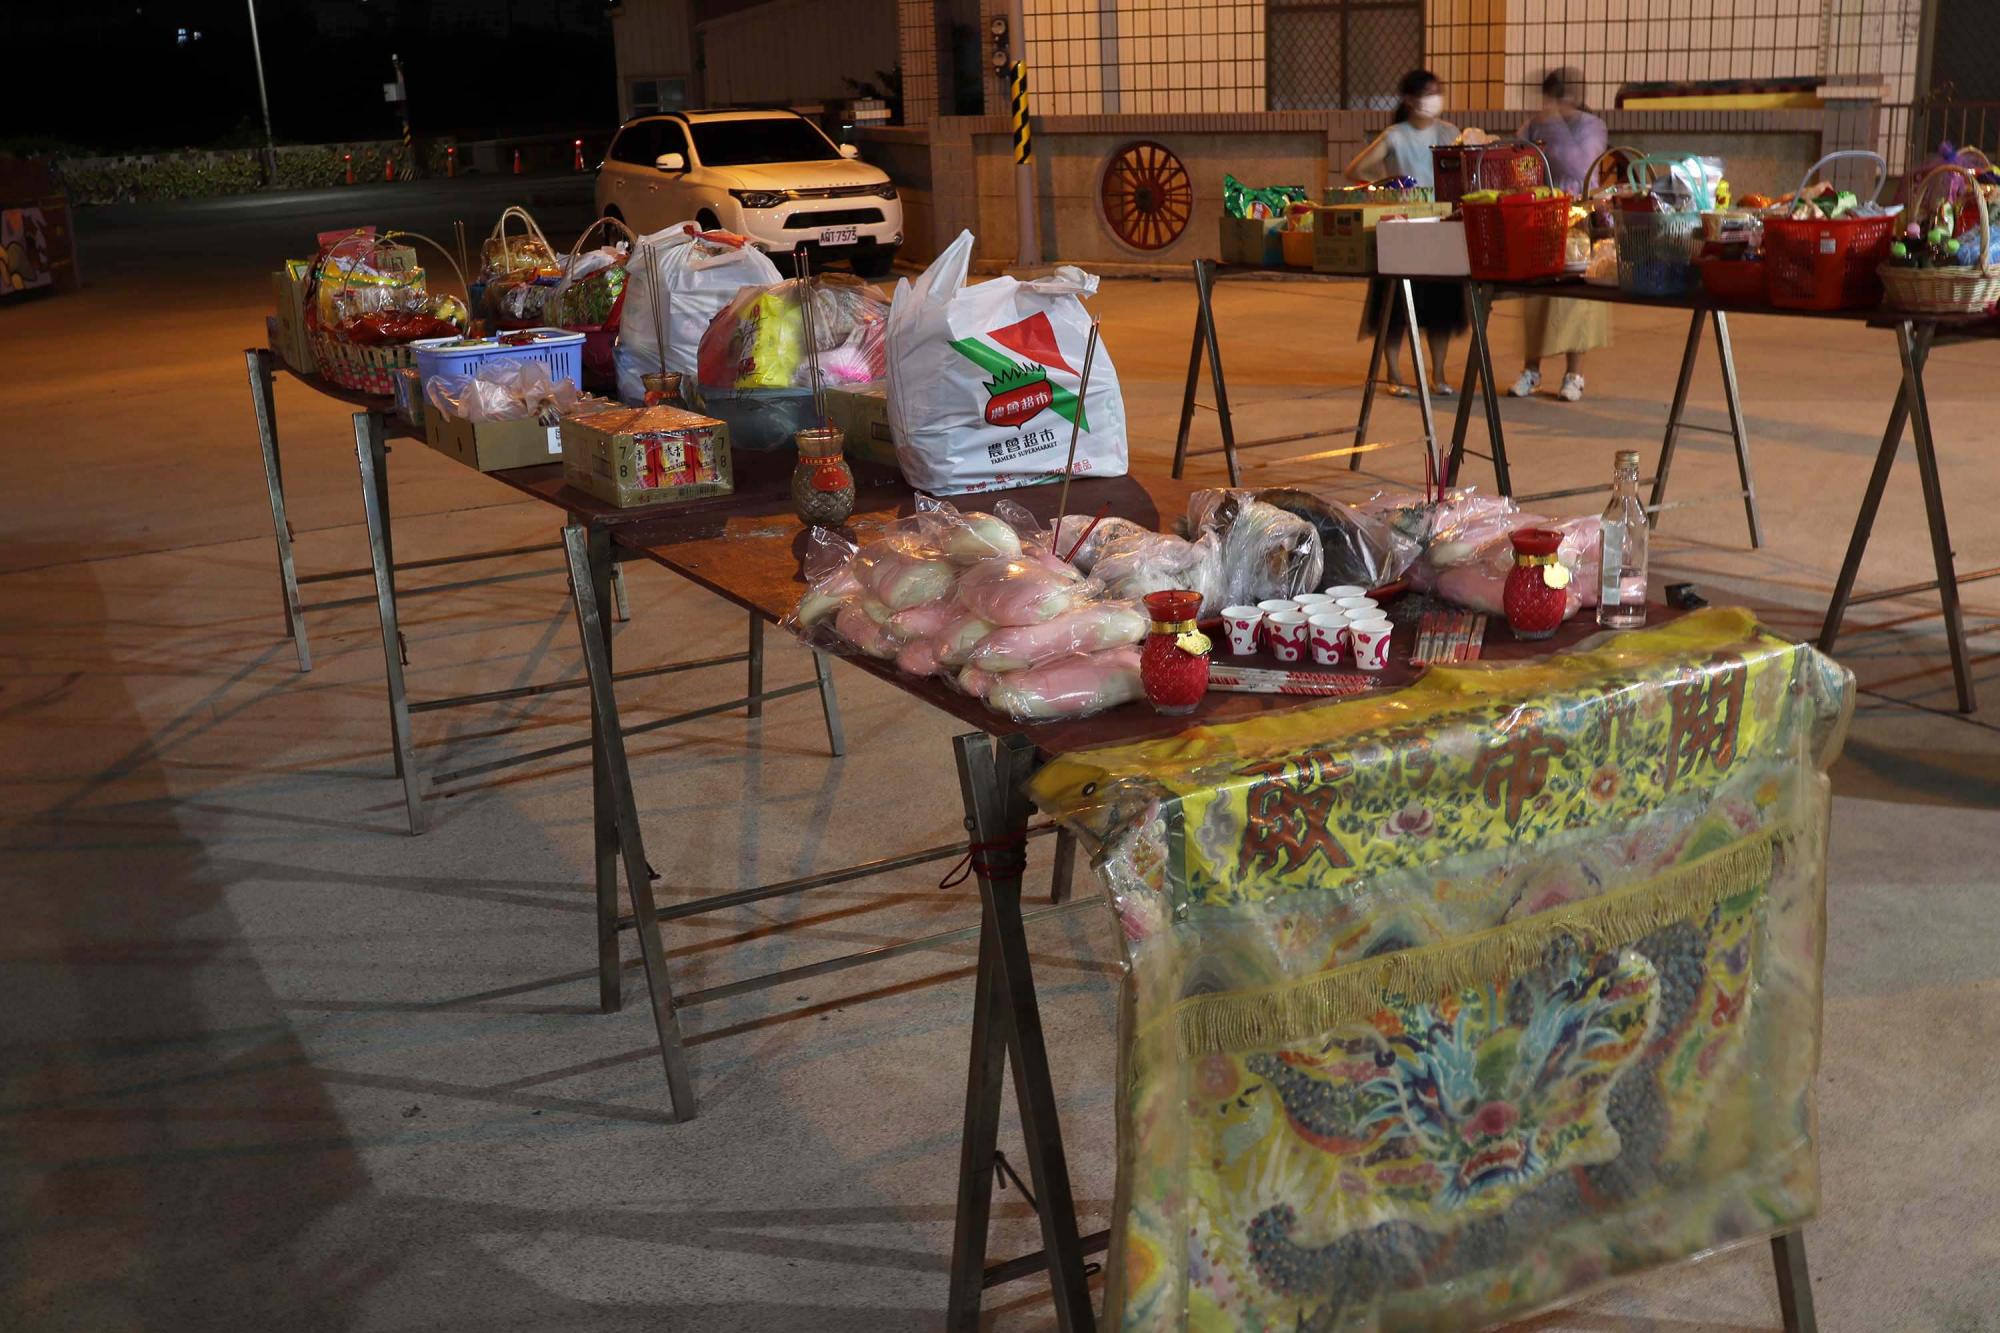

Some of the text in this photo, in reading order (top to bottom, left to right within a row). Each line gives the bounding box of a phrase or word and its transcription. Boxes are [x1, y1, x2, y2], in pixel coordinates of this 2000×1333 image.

[987, 428, 1056, 459] 農會超市
[990, 441, 1057, 465] FARMERS SUPERMARKET
